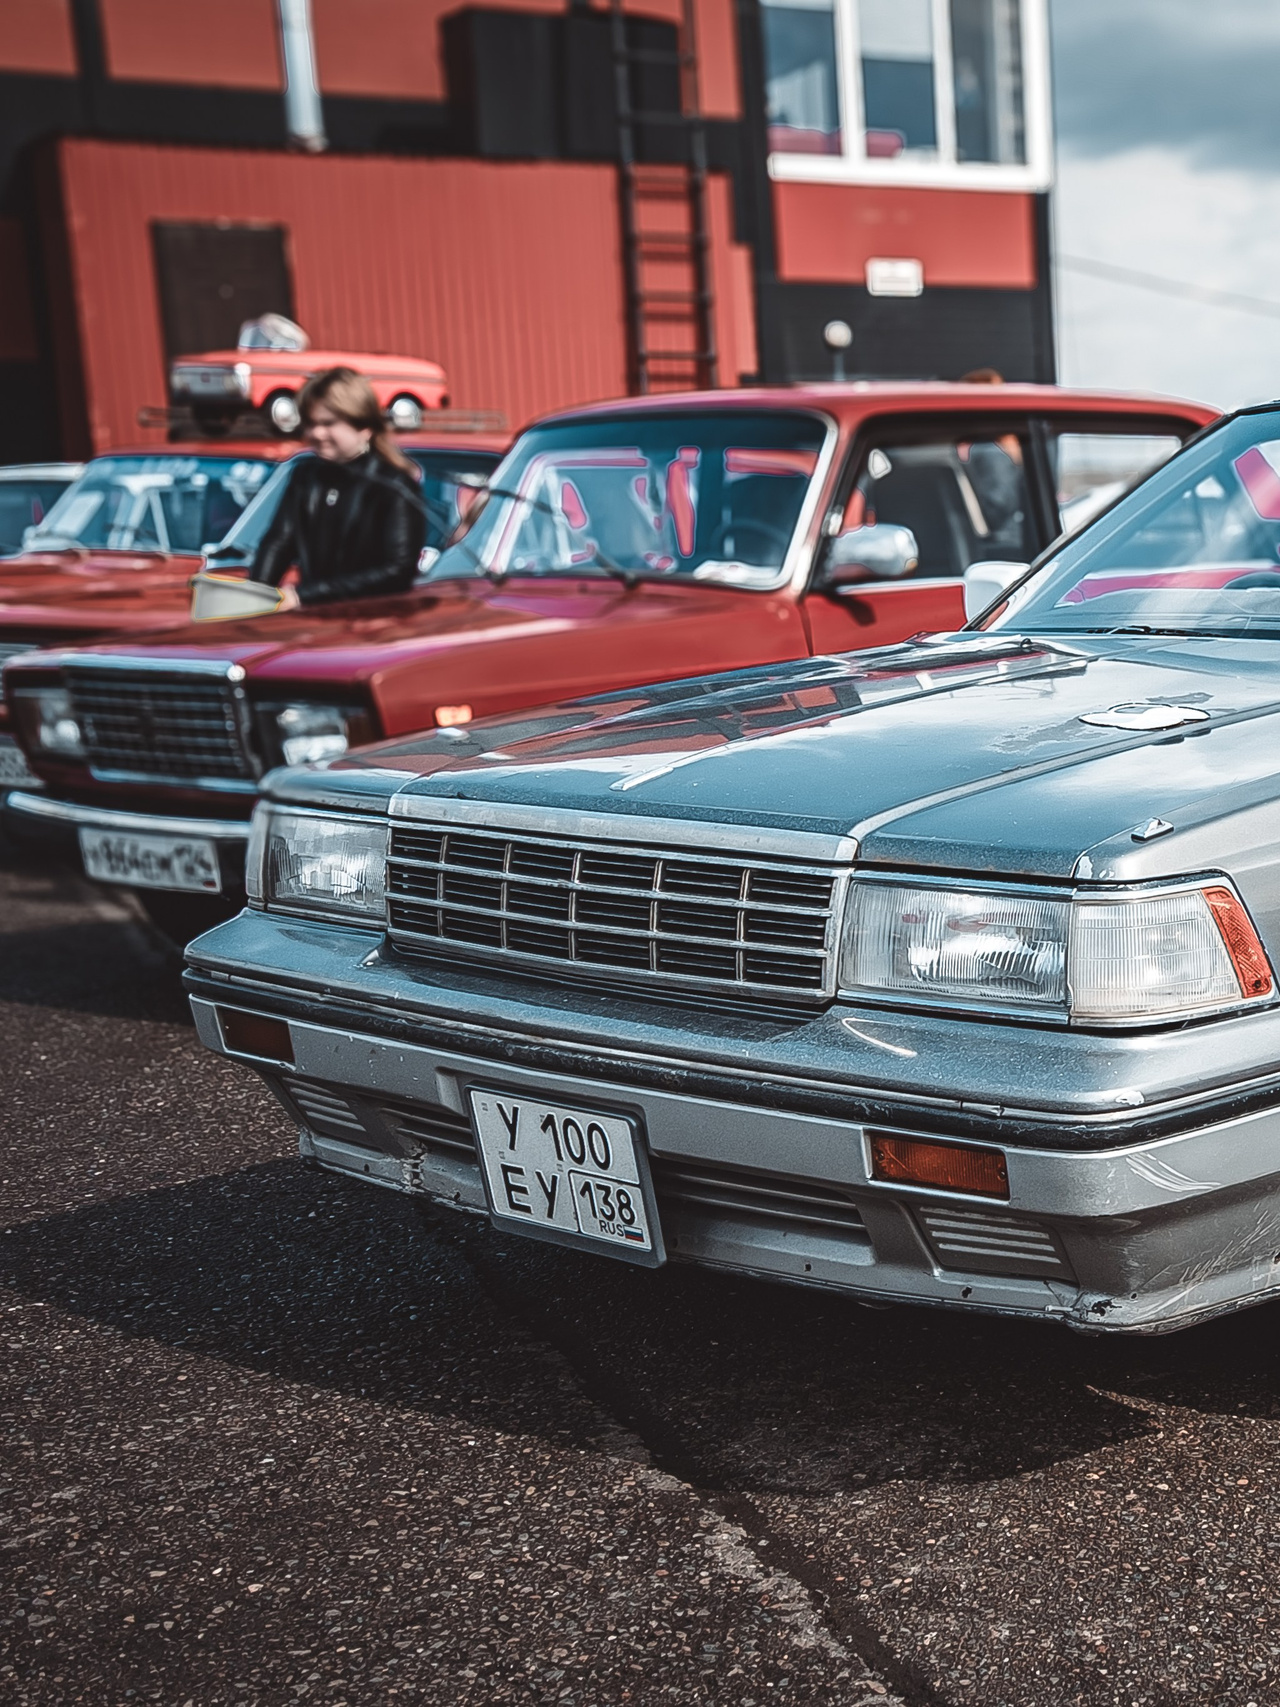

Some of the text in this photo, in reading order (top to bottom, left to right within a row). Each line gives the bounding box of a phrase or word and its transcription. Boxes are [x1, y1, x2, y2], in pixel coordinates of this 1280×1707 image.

[540, 1113, 612, 1171] 100
[579, 1180, 636, 1226] 138
[599, 1220, 625, 1237] RUS
